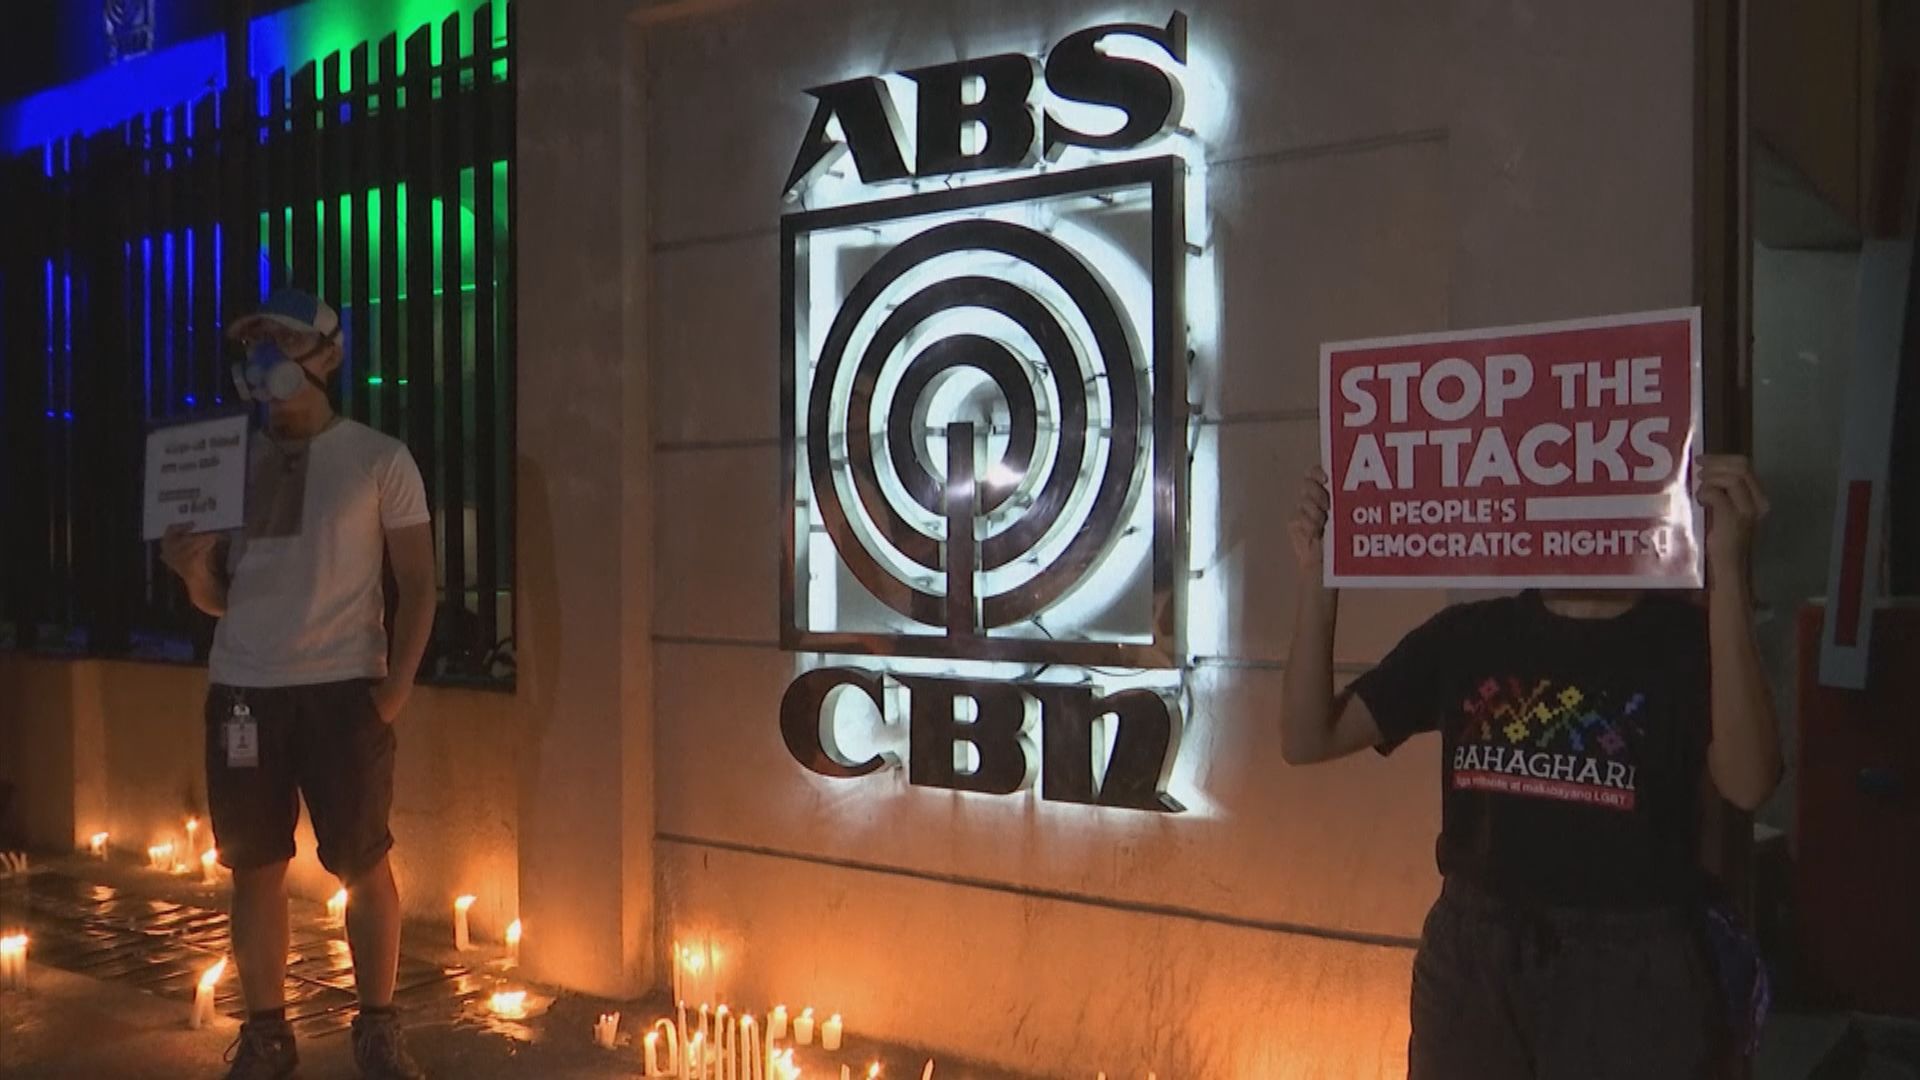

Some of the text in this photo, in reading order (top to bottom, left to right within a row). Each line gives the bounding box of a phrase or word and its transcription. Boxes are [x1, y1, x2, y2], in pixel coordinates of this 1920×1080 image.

[783, 10, 1188, 197] ABS
[1340, 354, 1662, 427] STOP THE
[1343, 416, 1673, 491] ATTACKS
[1353, 498, 1516, 525] ON PEOPLE'S
[1353, 532, 1531, 557] DEMOCRATIC
[1454, 745, 1635, 790] BAHAGHARI
